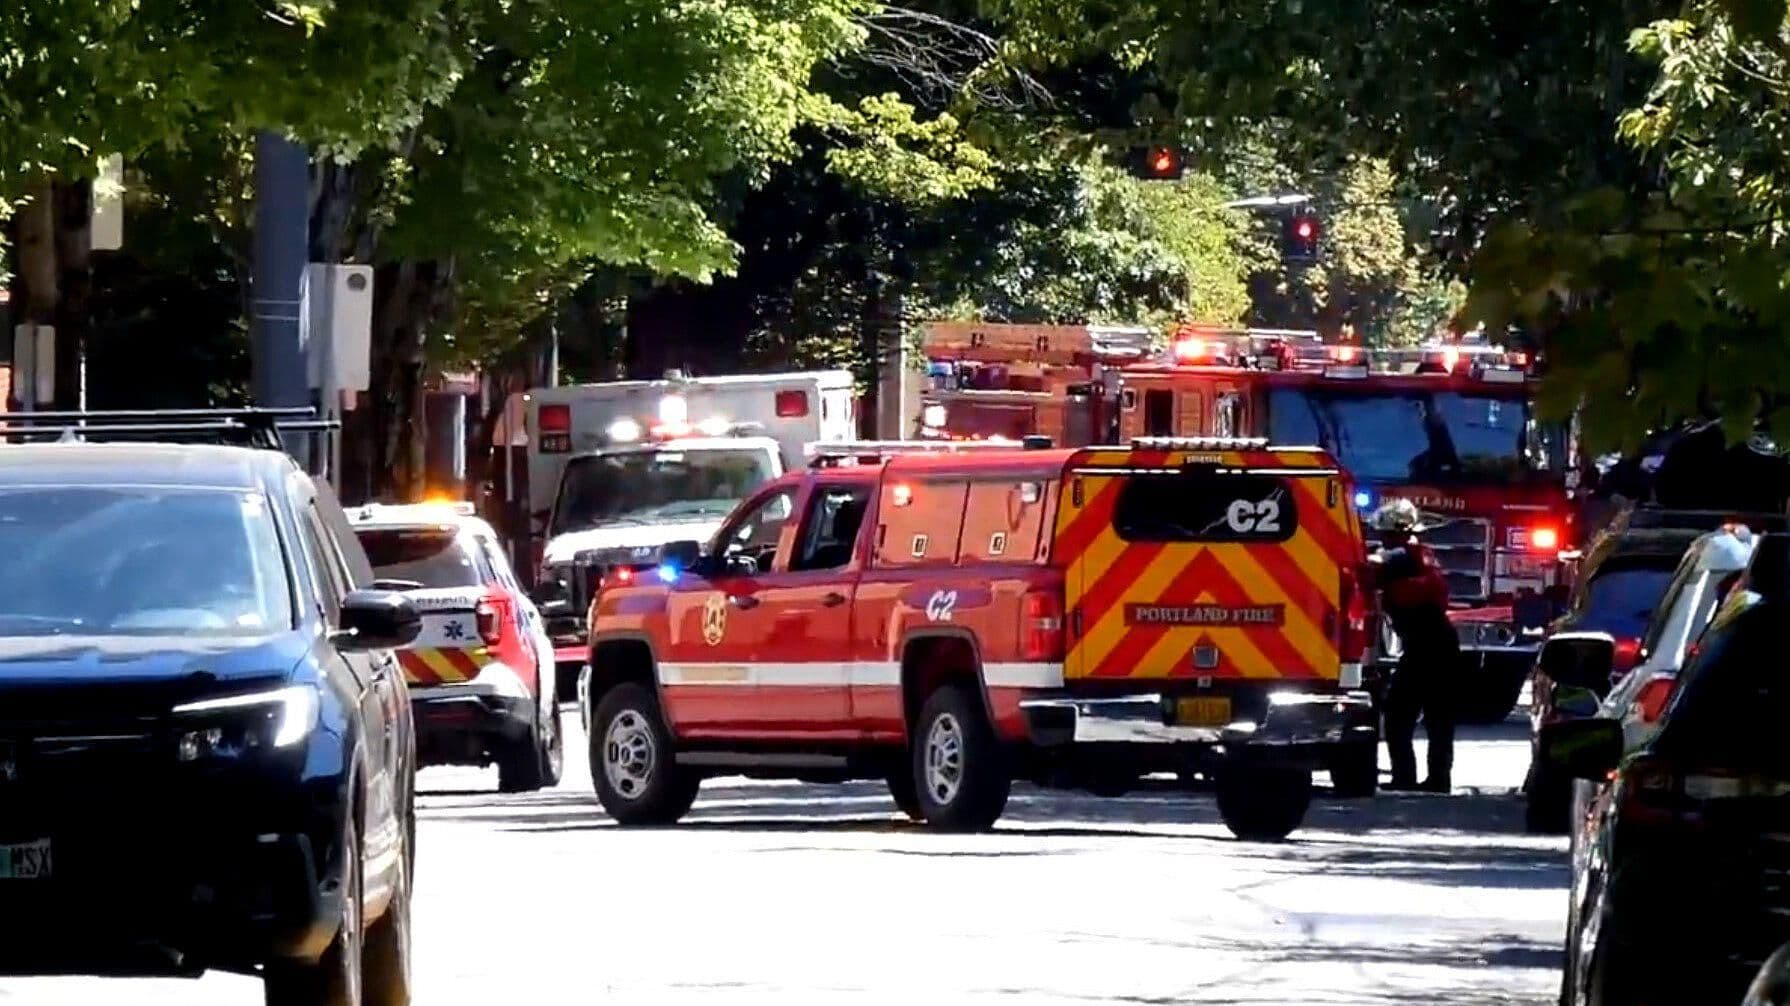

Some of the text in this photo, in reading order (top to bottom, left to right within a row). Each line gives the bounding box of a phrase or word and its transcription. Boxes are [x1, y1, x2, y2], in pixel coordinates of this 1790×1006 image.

[1227, 498, 1280, 532] C2
[926, 589, 957, 622] C2
[1136, 607, 1275, 623] PORTLAND FIRE
